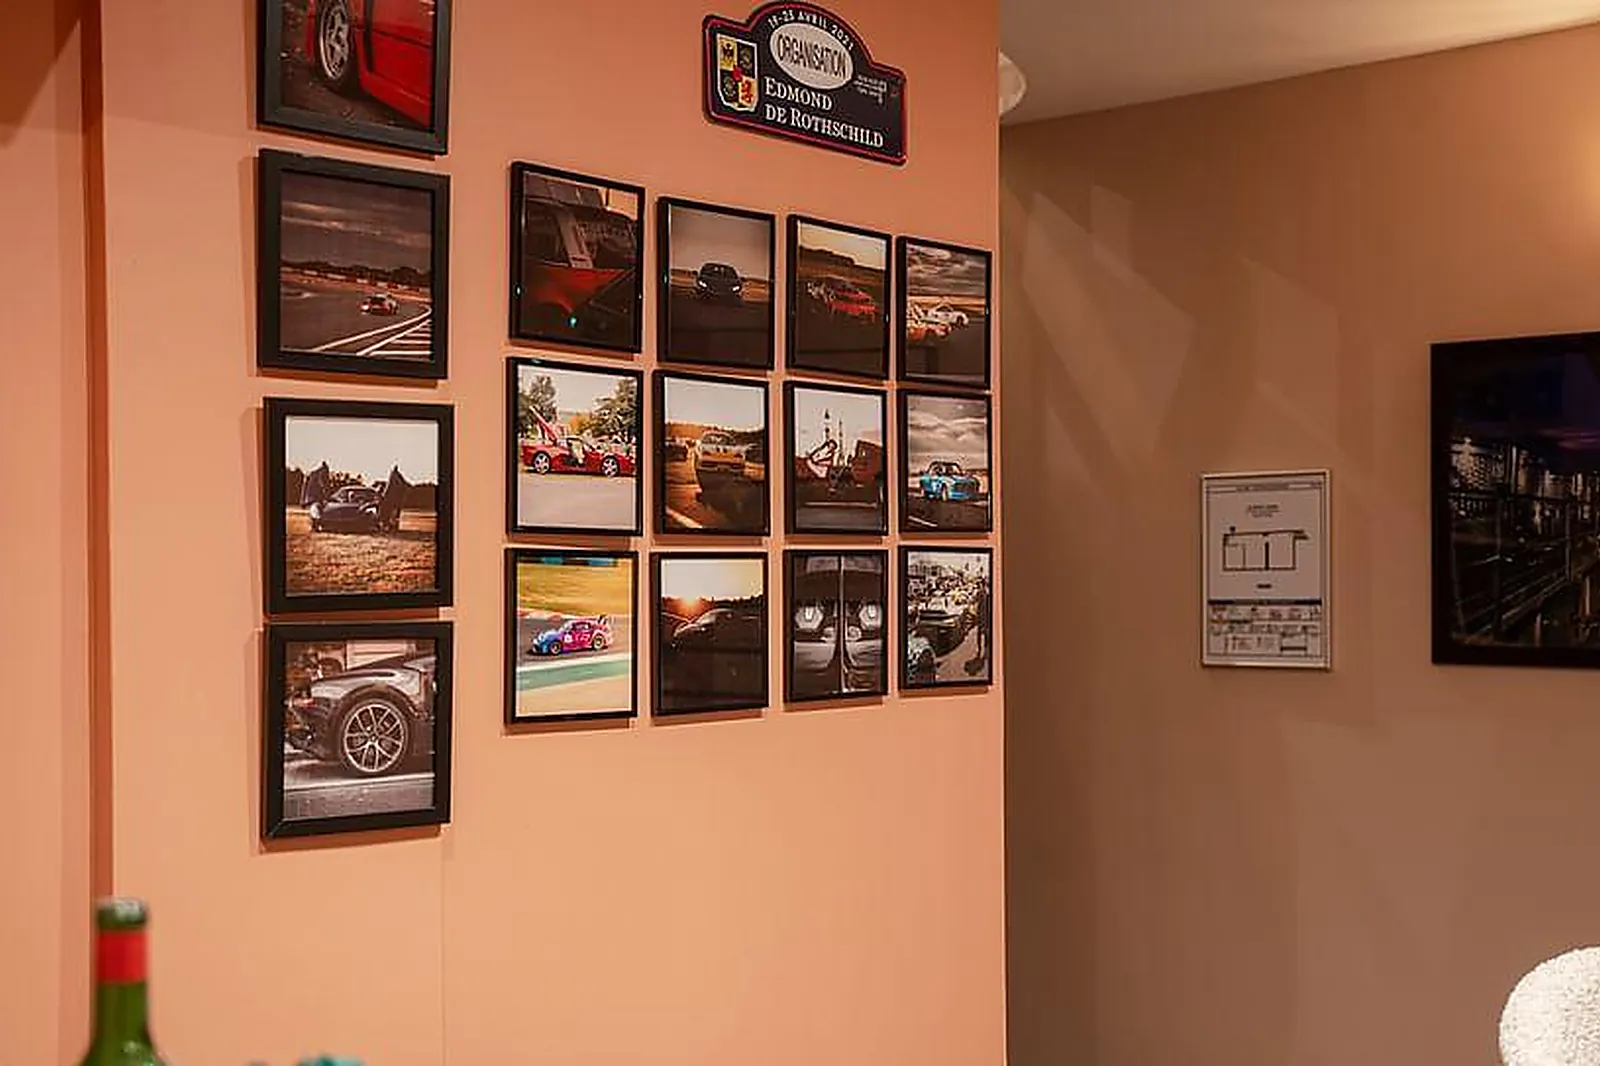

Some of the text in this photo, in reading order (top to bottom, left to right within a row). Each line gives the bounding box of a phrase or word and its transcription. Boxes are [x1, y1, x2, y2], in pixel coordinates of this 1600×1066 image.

[797, 12, 829, 29] AVRIL
[832, 24, 854, 50] 2021
[777, 34, 847, 78] ORGANISATION
[764, 76, 833, 111] EDMOND
[765, 103, 884, 148] DE ROTHSCHILD
